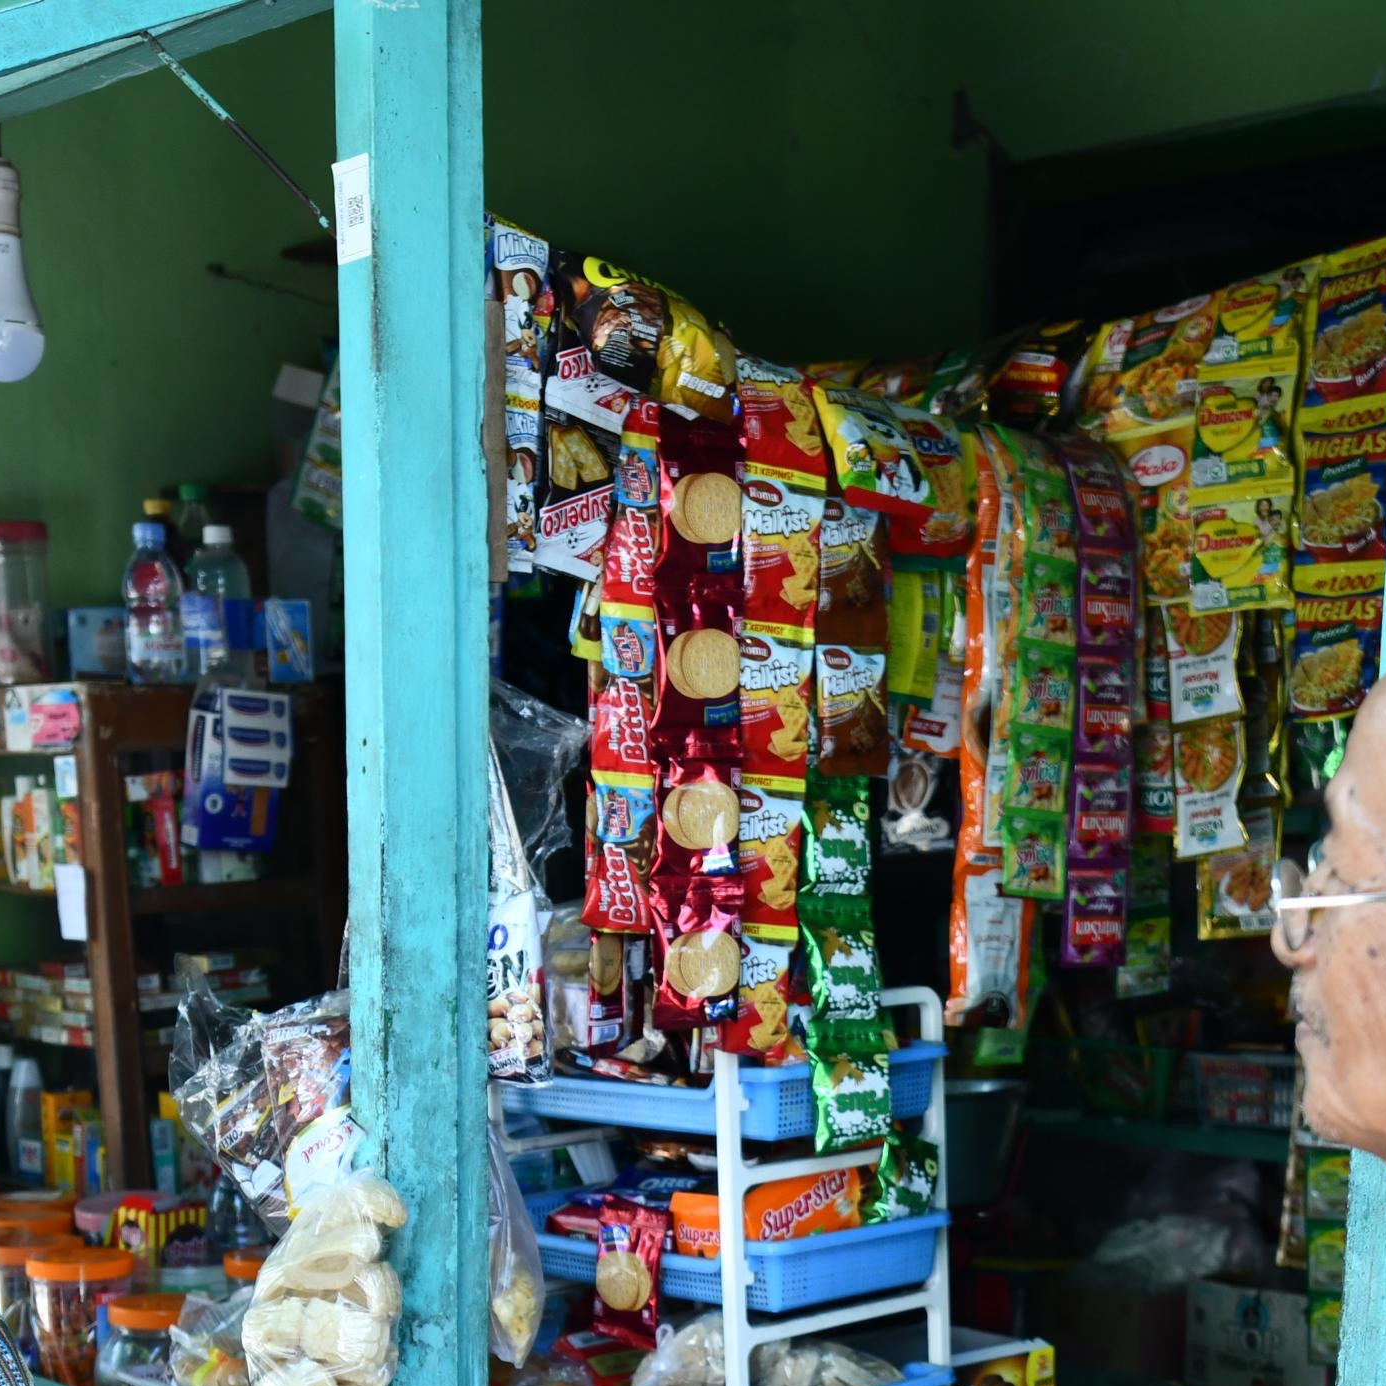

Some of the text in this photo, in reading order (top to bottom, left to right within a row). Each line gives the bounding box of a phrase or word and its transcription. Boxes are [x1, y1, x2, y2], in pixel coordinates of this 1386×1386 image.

[748, 486, 779, 503] Roma
[542, 491, 613, 539] Superco
[743, 506, 811, 539] Malkist
[820, 518, 868, 549] Malkist
[625, 508, 655, 596] Better
[1295, 598, 1377, 623] MIGELAS
[739, 661, 800, 693] Malkist
[821, 668, 875, 700] Malkist
[619, 677, 649, 764] Better
[739, 809, 788, 845] alkist
[603, 843, 636, 925] Better
[740, 956, 778, 990] lkist
[760, 1168, 849, 1241] Superstar
[677, 1223, 721, 1248] Supers
